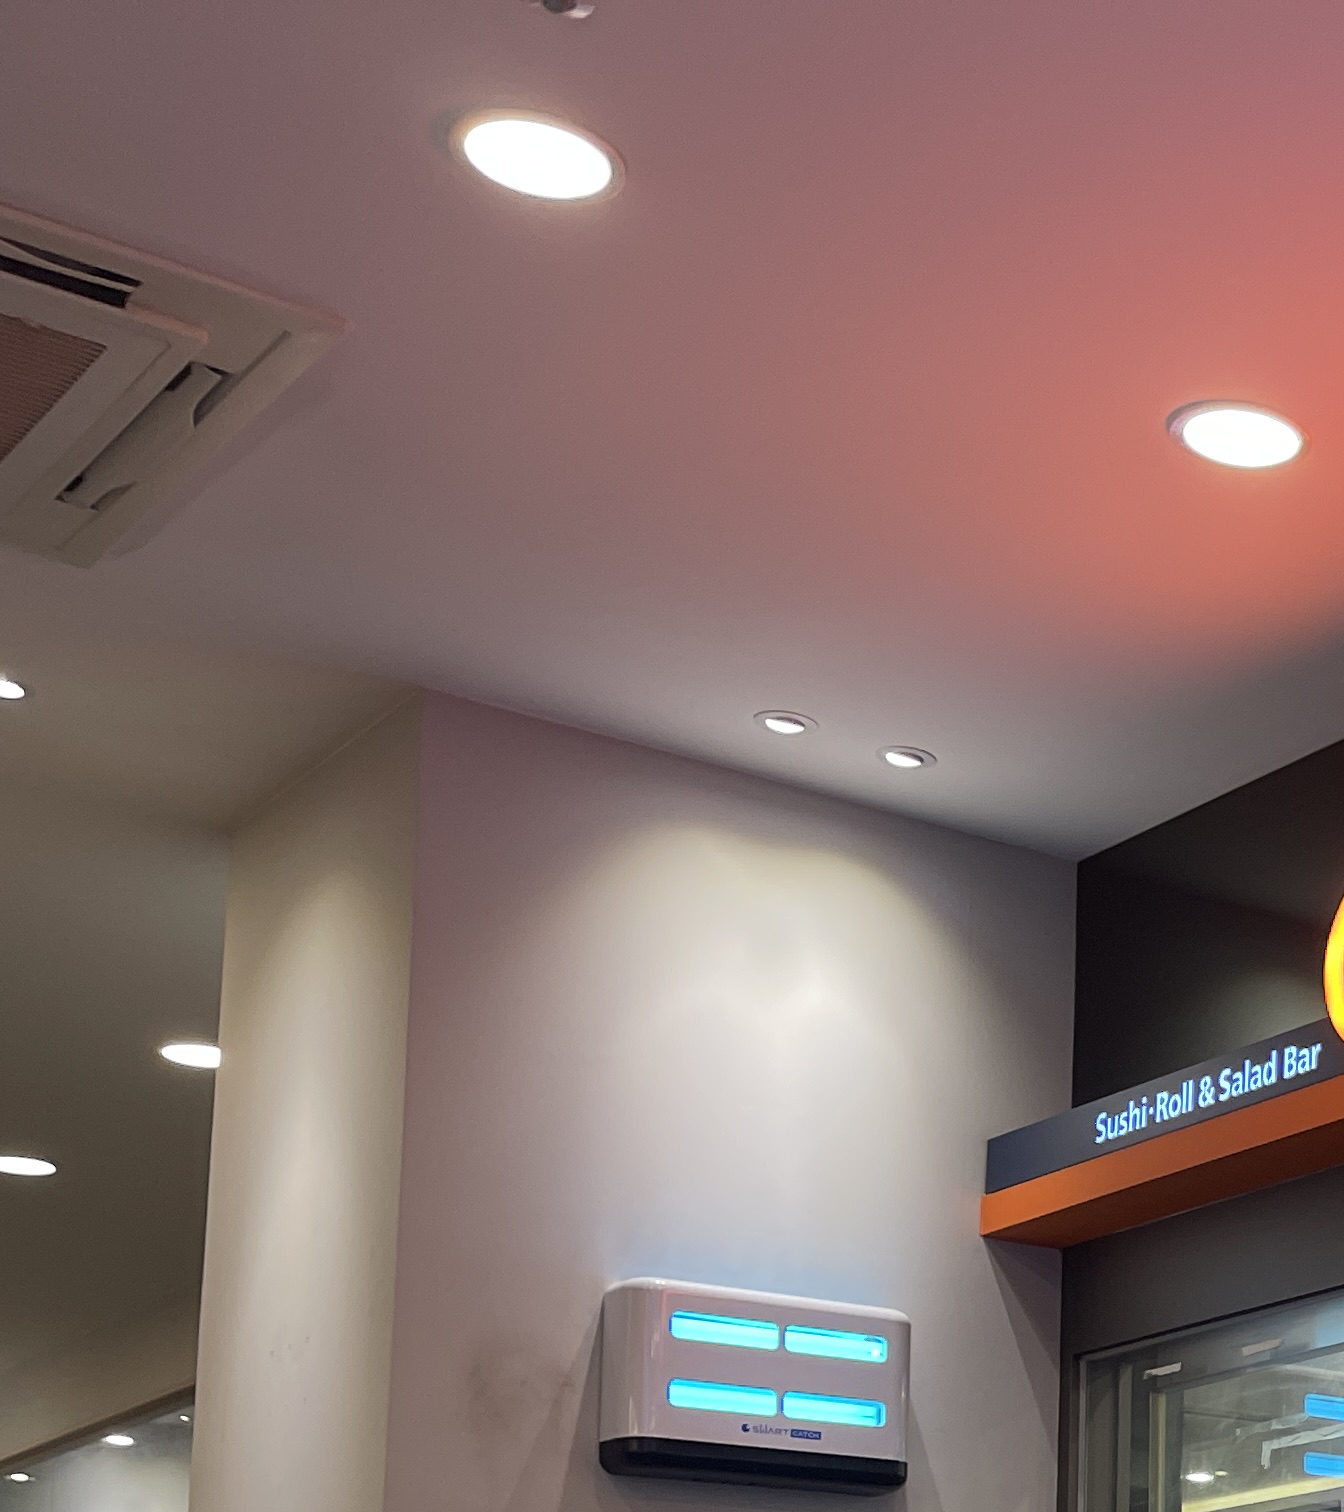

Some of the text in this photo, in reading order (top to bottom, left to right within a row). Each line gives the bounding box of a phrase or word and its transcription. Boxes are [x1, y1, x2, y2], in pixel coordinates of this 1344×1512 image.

[1198, 1075, 1216, 1108] &
[1218, 1049, 1279, 1102] Salad
[1283, 1042, 1322, 1080] Bar
